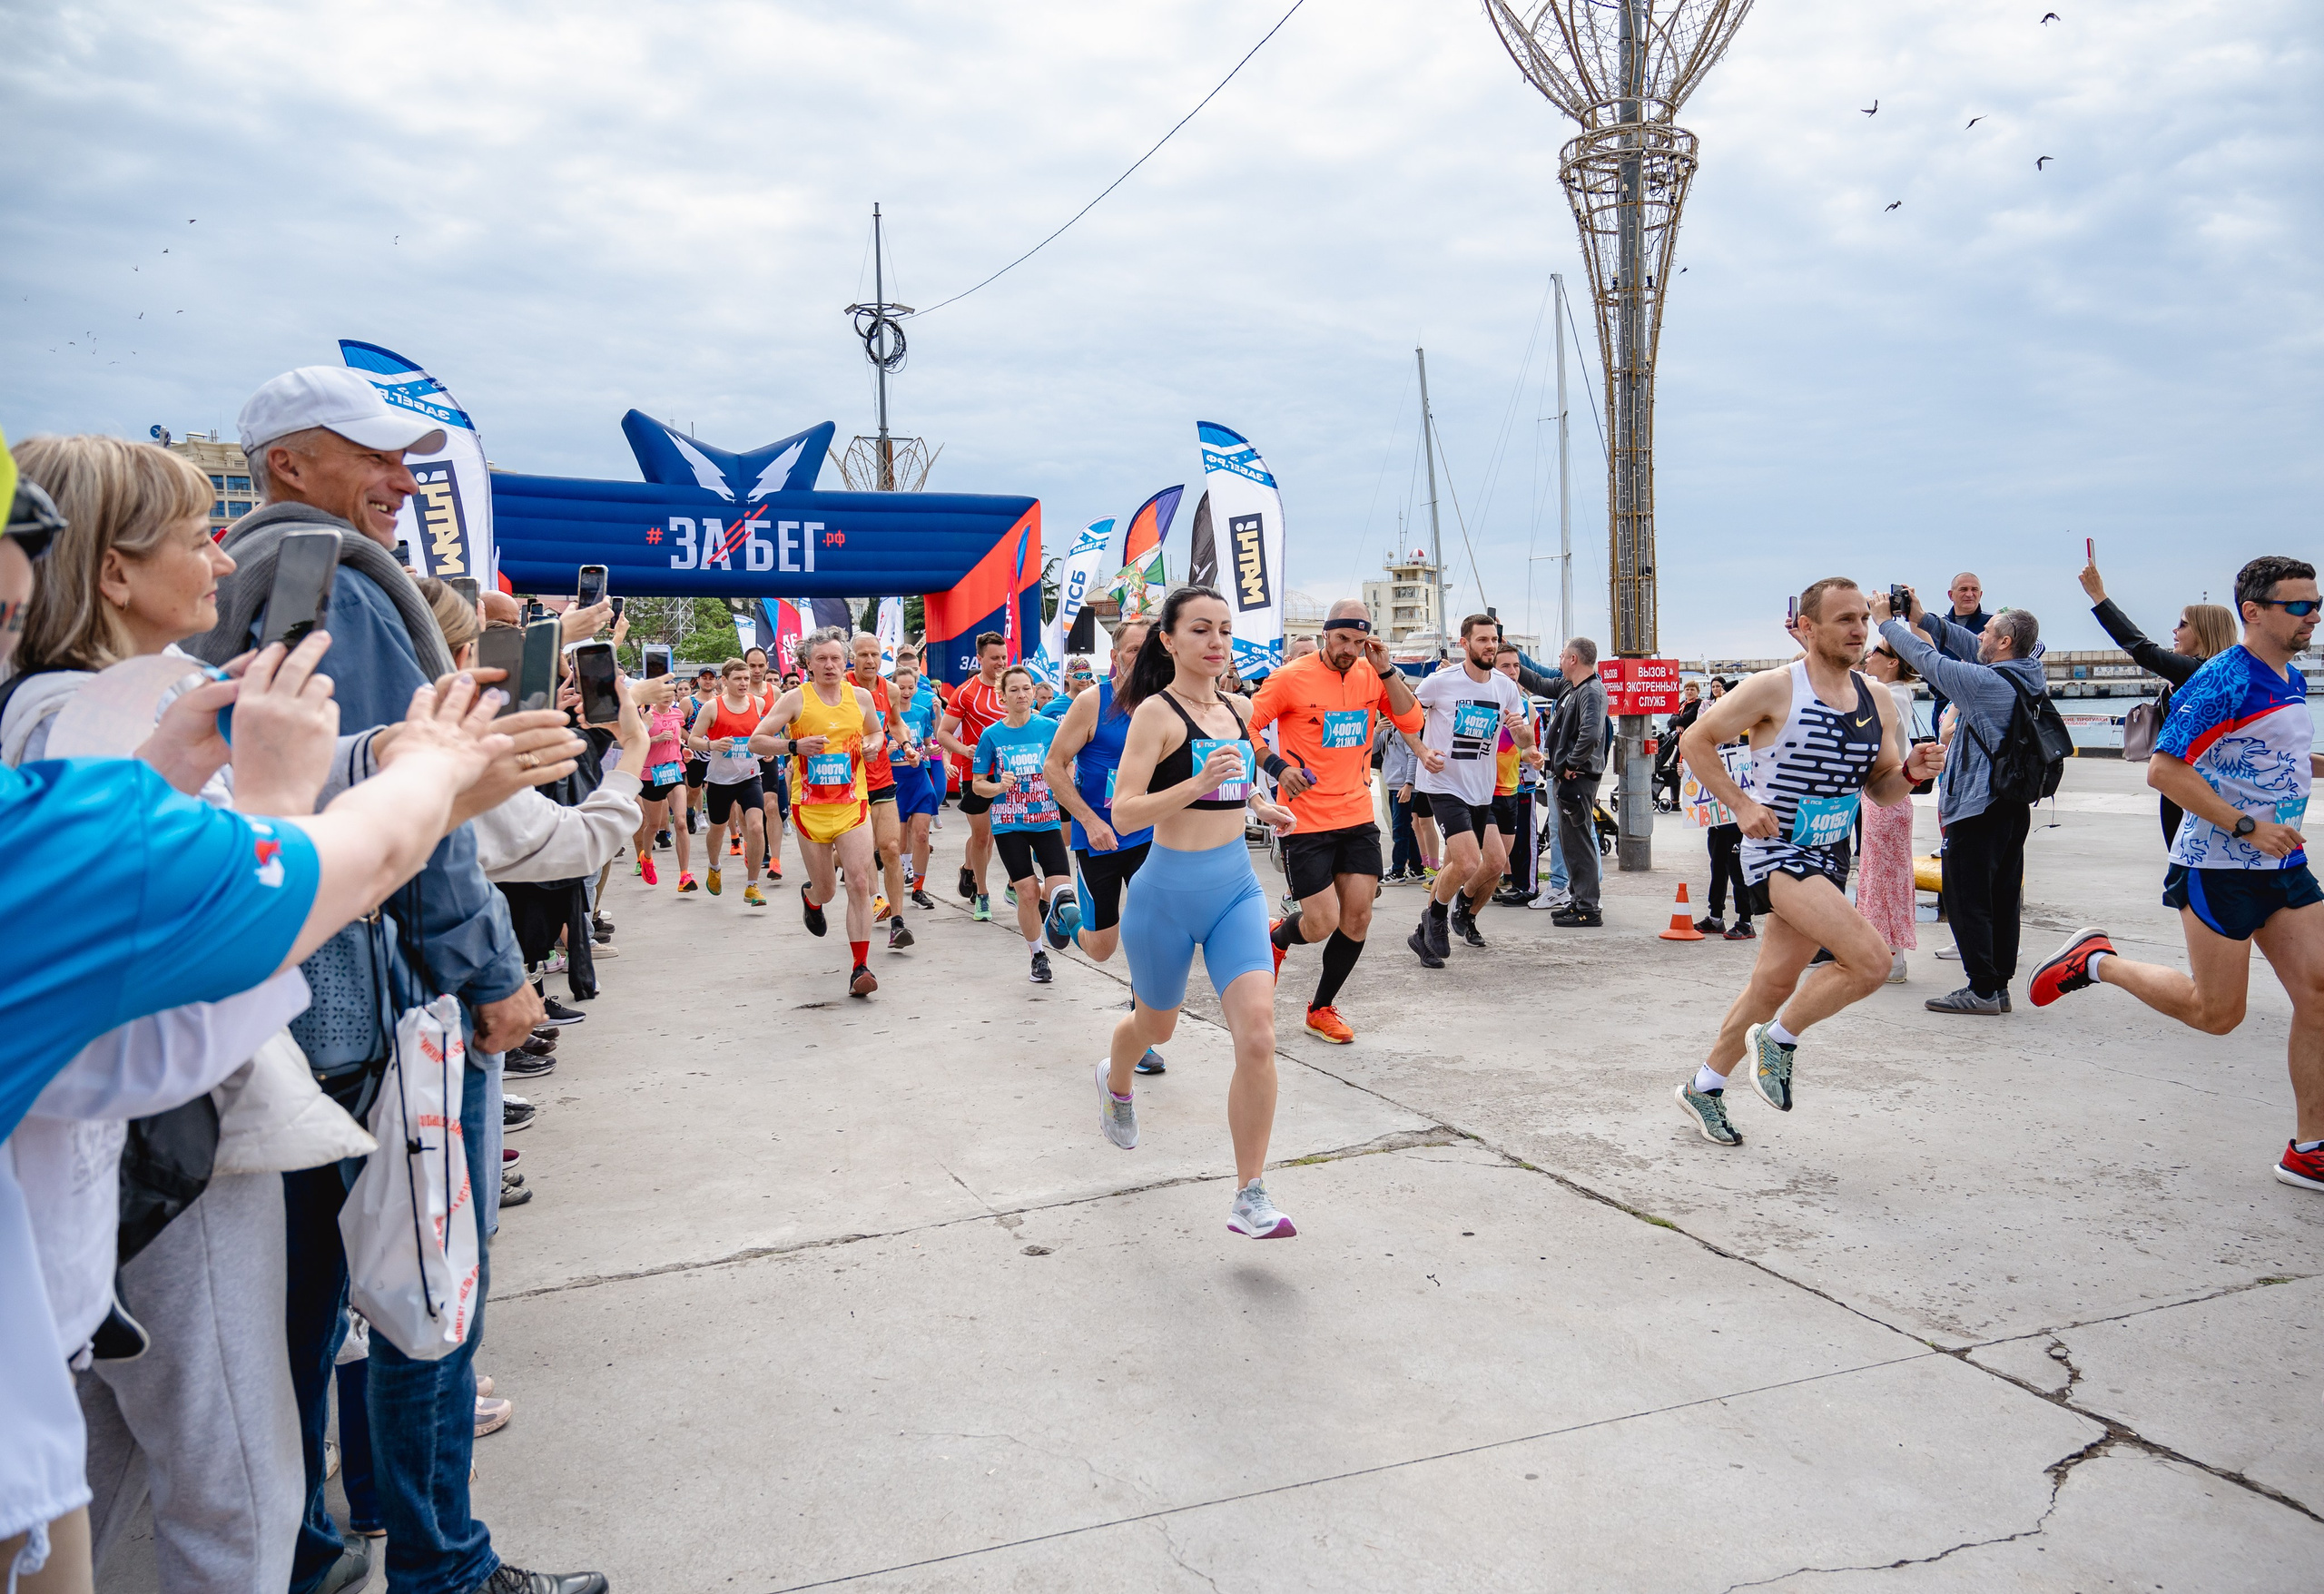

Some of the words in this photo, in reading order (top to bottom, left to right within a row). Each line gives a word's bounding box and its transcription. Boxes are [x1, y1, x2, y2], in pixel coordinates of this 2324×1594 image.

[1064, 570, 1087, 616] ПСБ
[1638, 666, 1666, 677] ВЫЗОВ
[1626, 681, 1678, 692] ЭКСТРЕННЫХ
[1639, 696, 1666, 707] СЛУЖБ
[1464, 714, 1489, 730] 40127
[1333, 722, 1362, 736] 40070
[1010, 753, 1039, 766] 40002
[816, 763, 844, 775] 40076
[1005, 789, 1049, 803] #ГОРДОСТЬ
[991, 802, 1028, 815] #ЛЮБОВЬ
[1810, 810, 1849, 831] 40152
